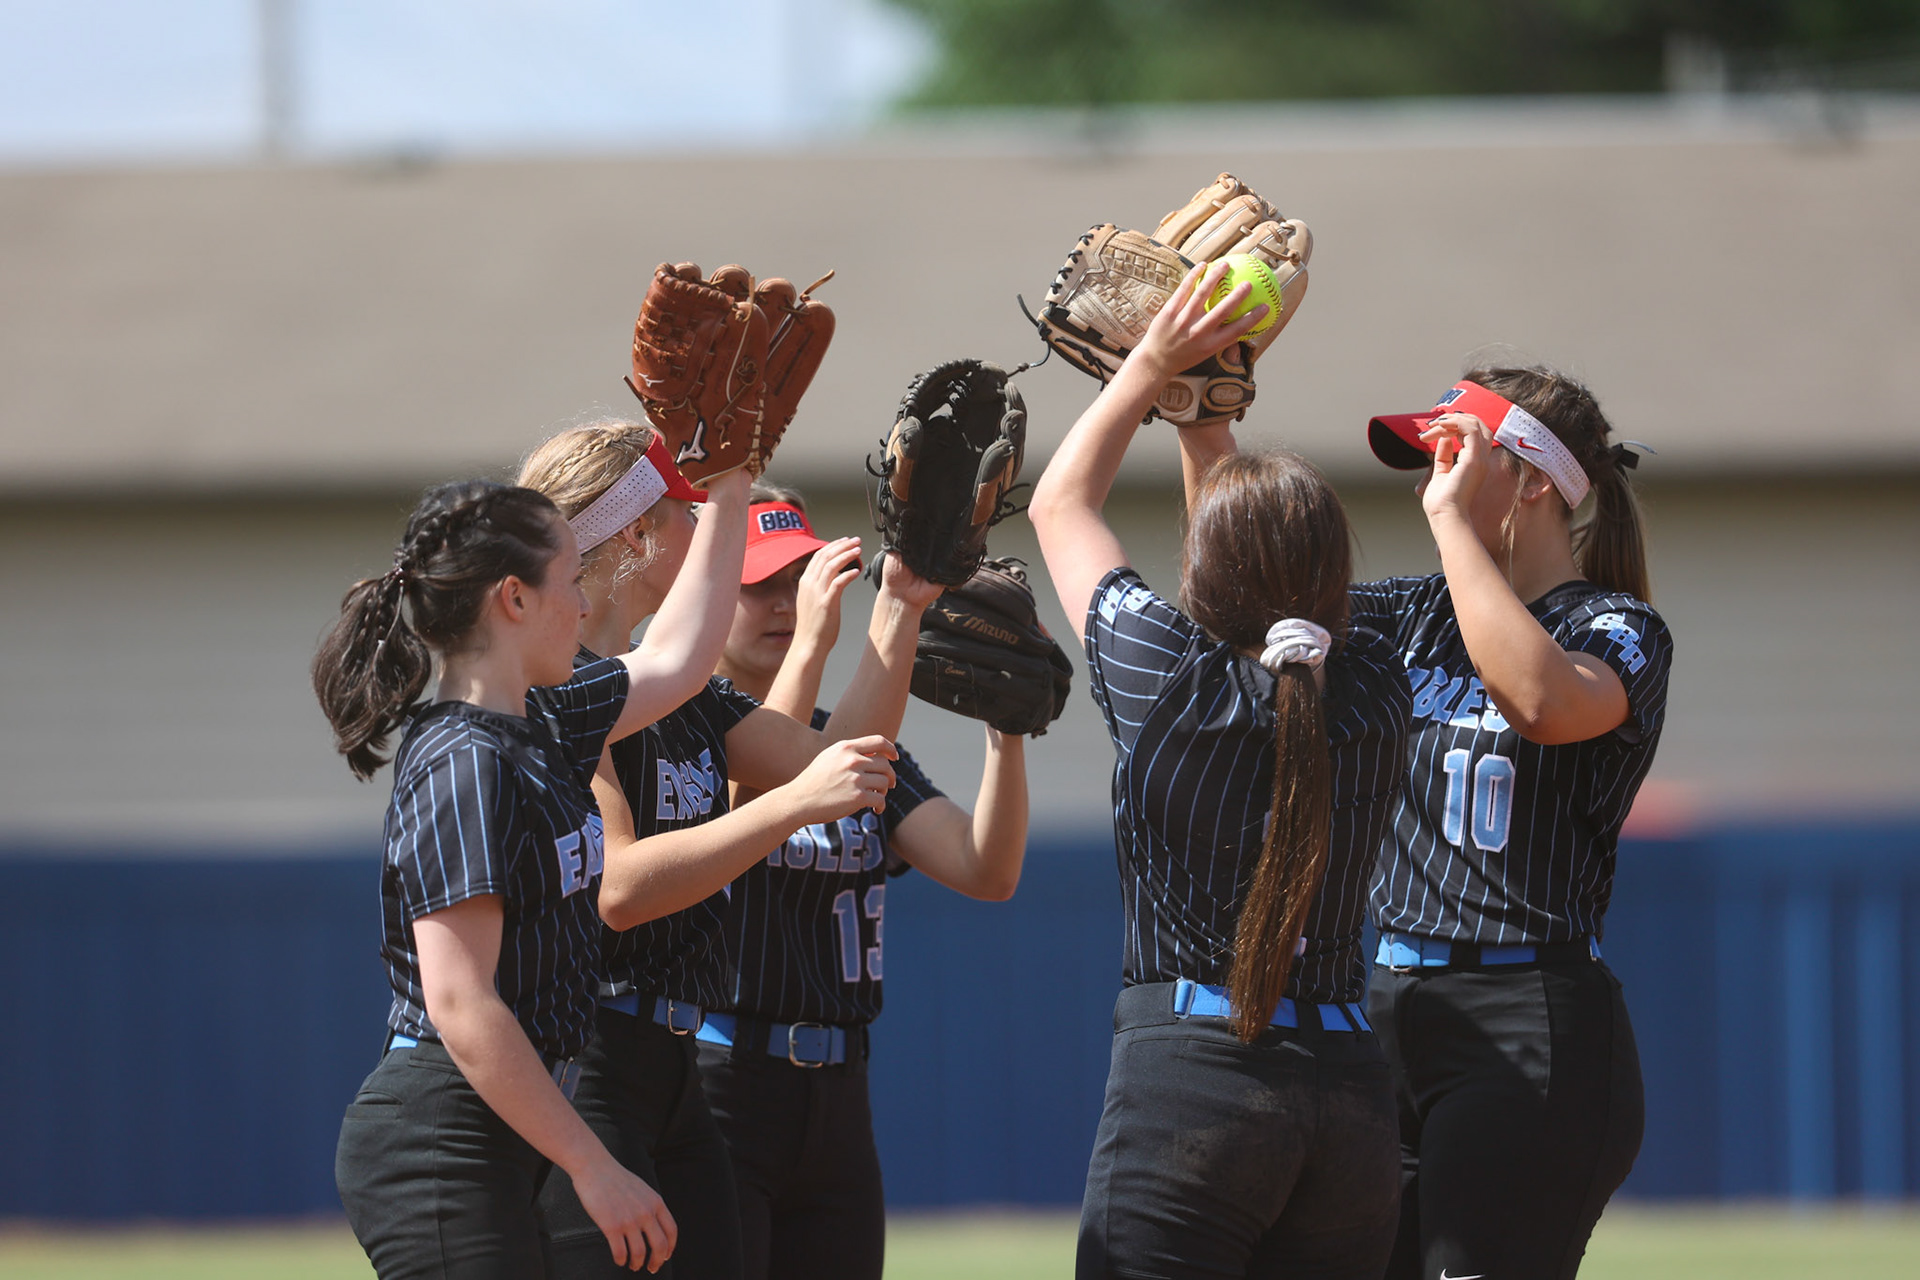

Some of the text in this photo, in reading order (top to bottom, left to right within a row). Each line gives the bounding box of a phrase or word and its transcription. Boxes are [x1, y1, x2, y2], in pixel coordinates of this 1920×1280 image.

[758, 510, 806, 534] BBA
[1590, 612, 1647, 675] BBA
[1442, 748, 1515, 853] 10
[832, 884, 886, 983] 13
